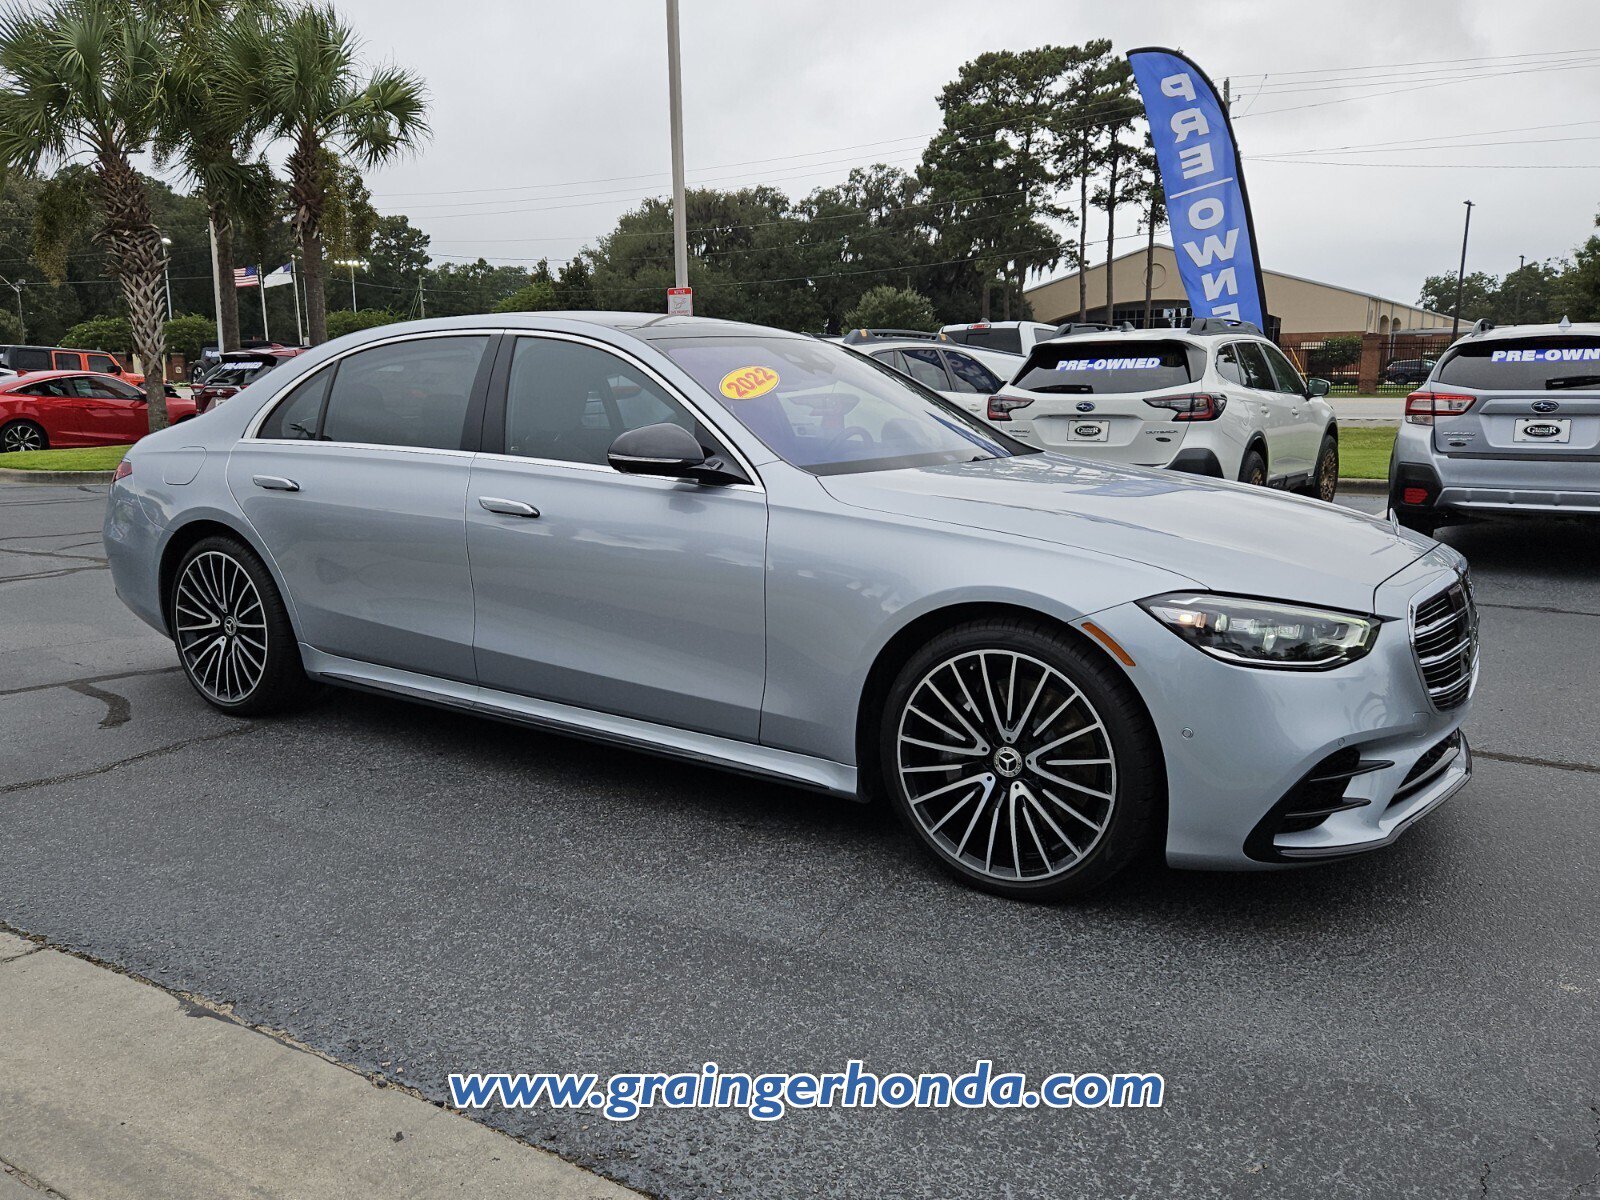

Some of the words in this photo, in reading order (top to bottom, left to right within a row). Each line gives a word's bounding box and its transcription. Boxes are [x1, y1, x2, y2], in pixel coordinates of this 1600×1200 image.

[1491, 348, 1600, 362] PRE-OWN
[1055, 357, 1161, 371] PRE-OWNED
[726, 367, 774, 397] 2022
